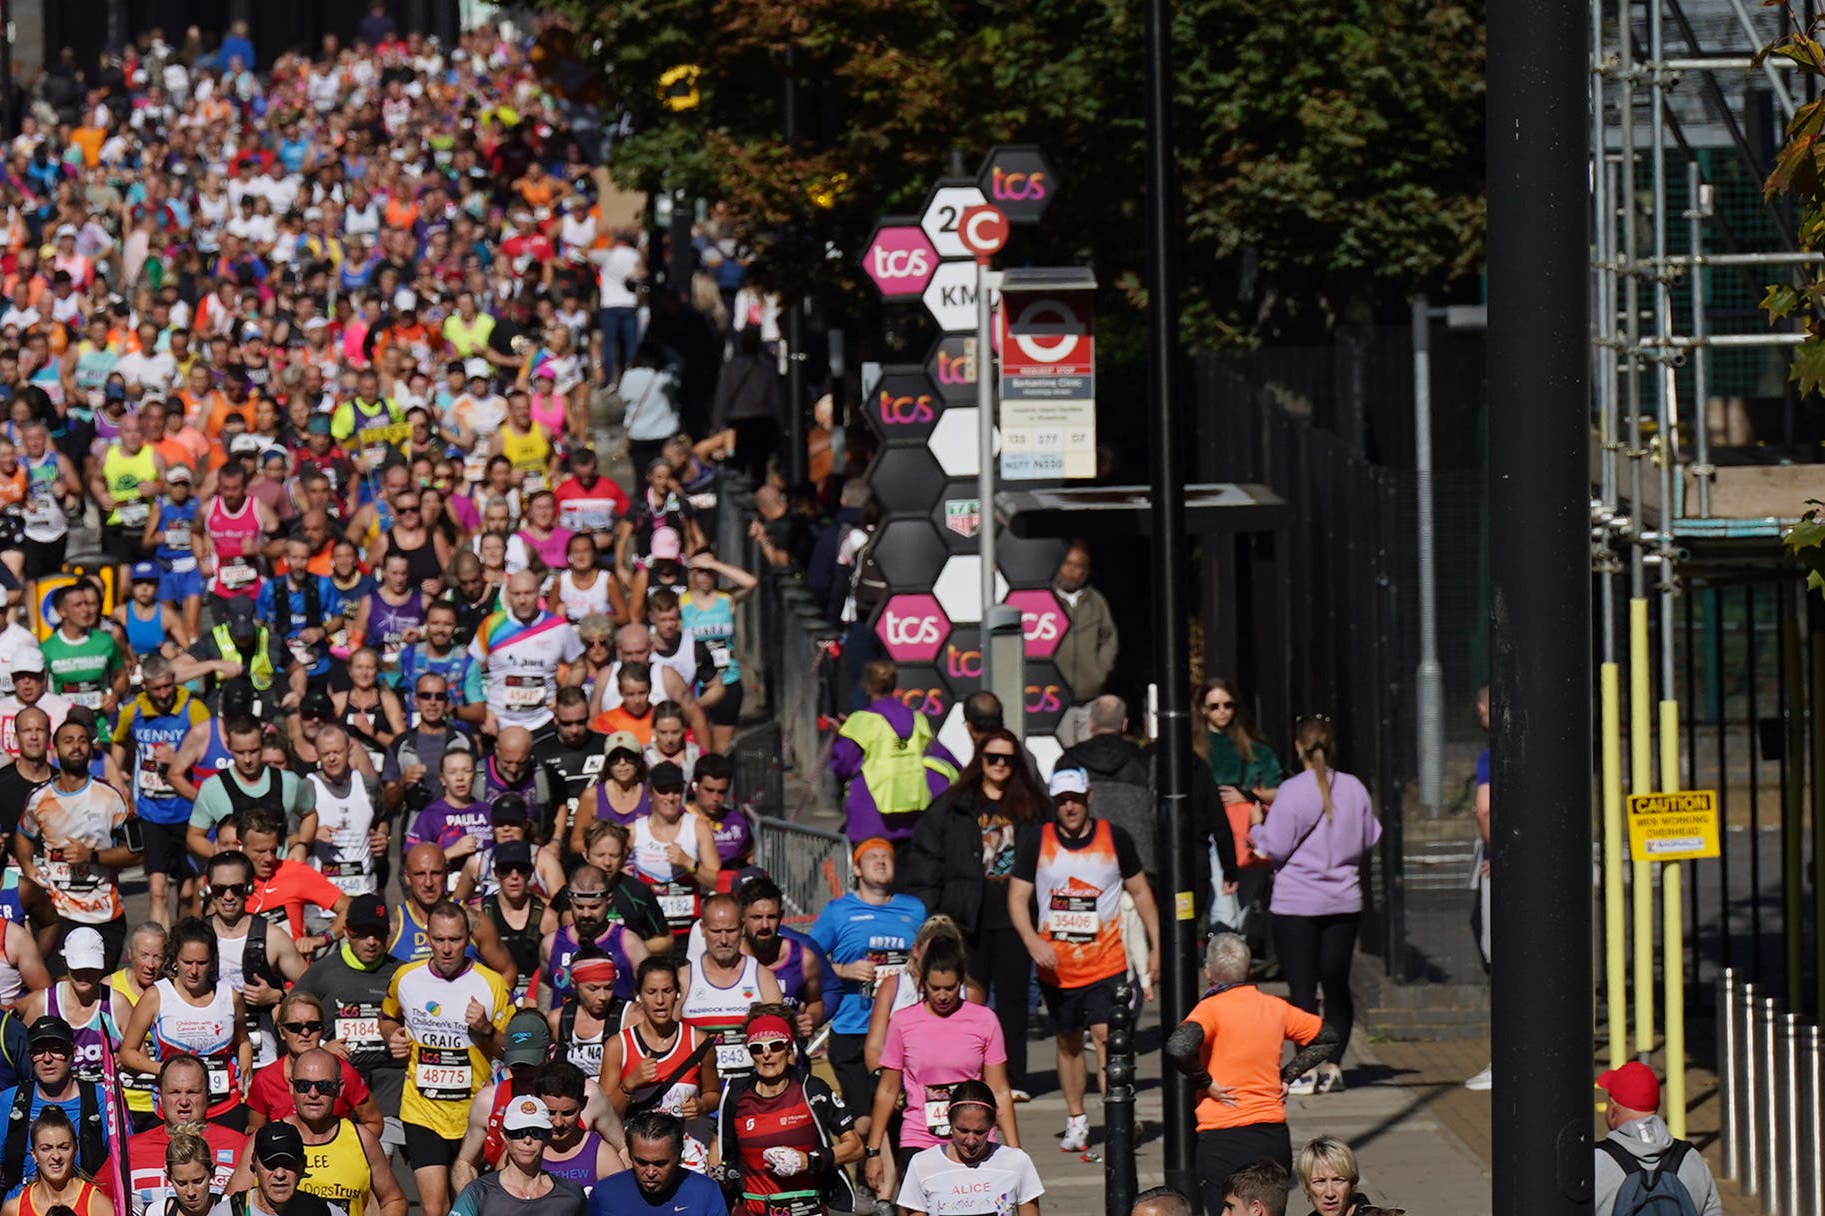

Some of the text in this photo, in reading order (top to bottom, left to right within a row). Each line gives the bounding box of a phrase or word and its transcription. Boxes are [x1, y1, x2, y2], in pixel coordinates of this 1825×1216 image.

[992, 166, 1046, 200] tcs
[966, 211, 1000, 249] C
[875, 245, 928, 279] tcs
[880, 390, 934, 424] tcs
[886, 610, 940, 645] tcs
[135, 727, 185, 743] KENNY
[1635, 795, 1708, 814] CAUTION
[446, 813, 487, 829] PAULA
[412, 1008, 427, 1018] The
[412, 1018, 451, 1030] Children's
[422, 1034, 461, 1048] CRAIG
[424, 1068, 465, 1083] 48775
[305, 1155, 330, 1169] LEE
[304, 1183, 362, 1200] DogsTrust
[951, 1182, 991, 1195] ALICE
